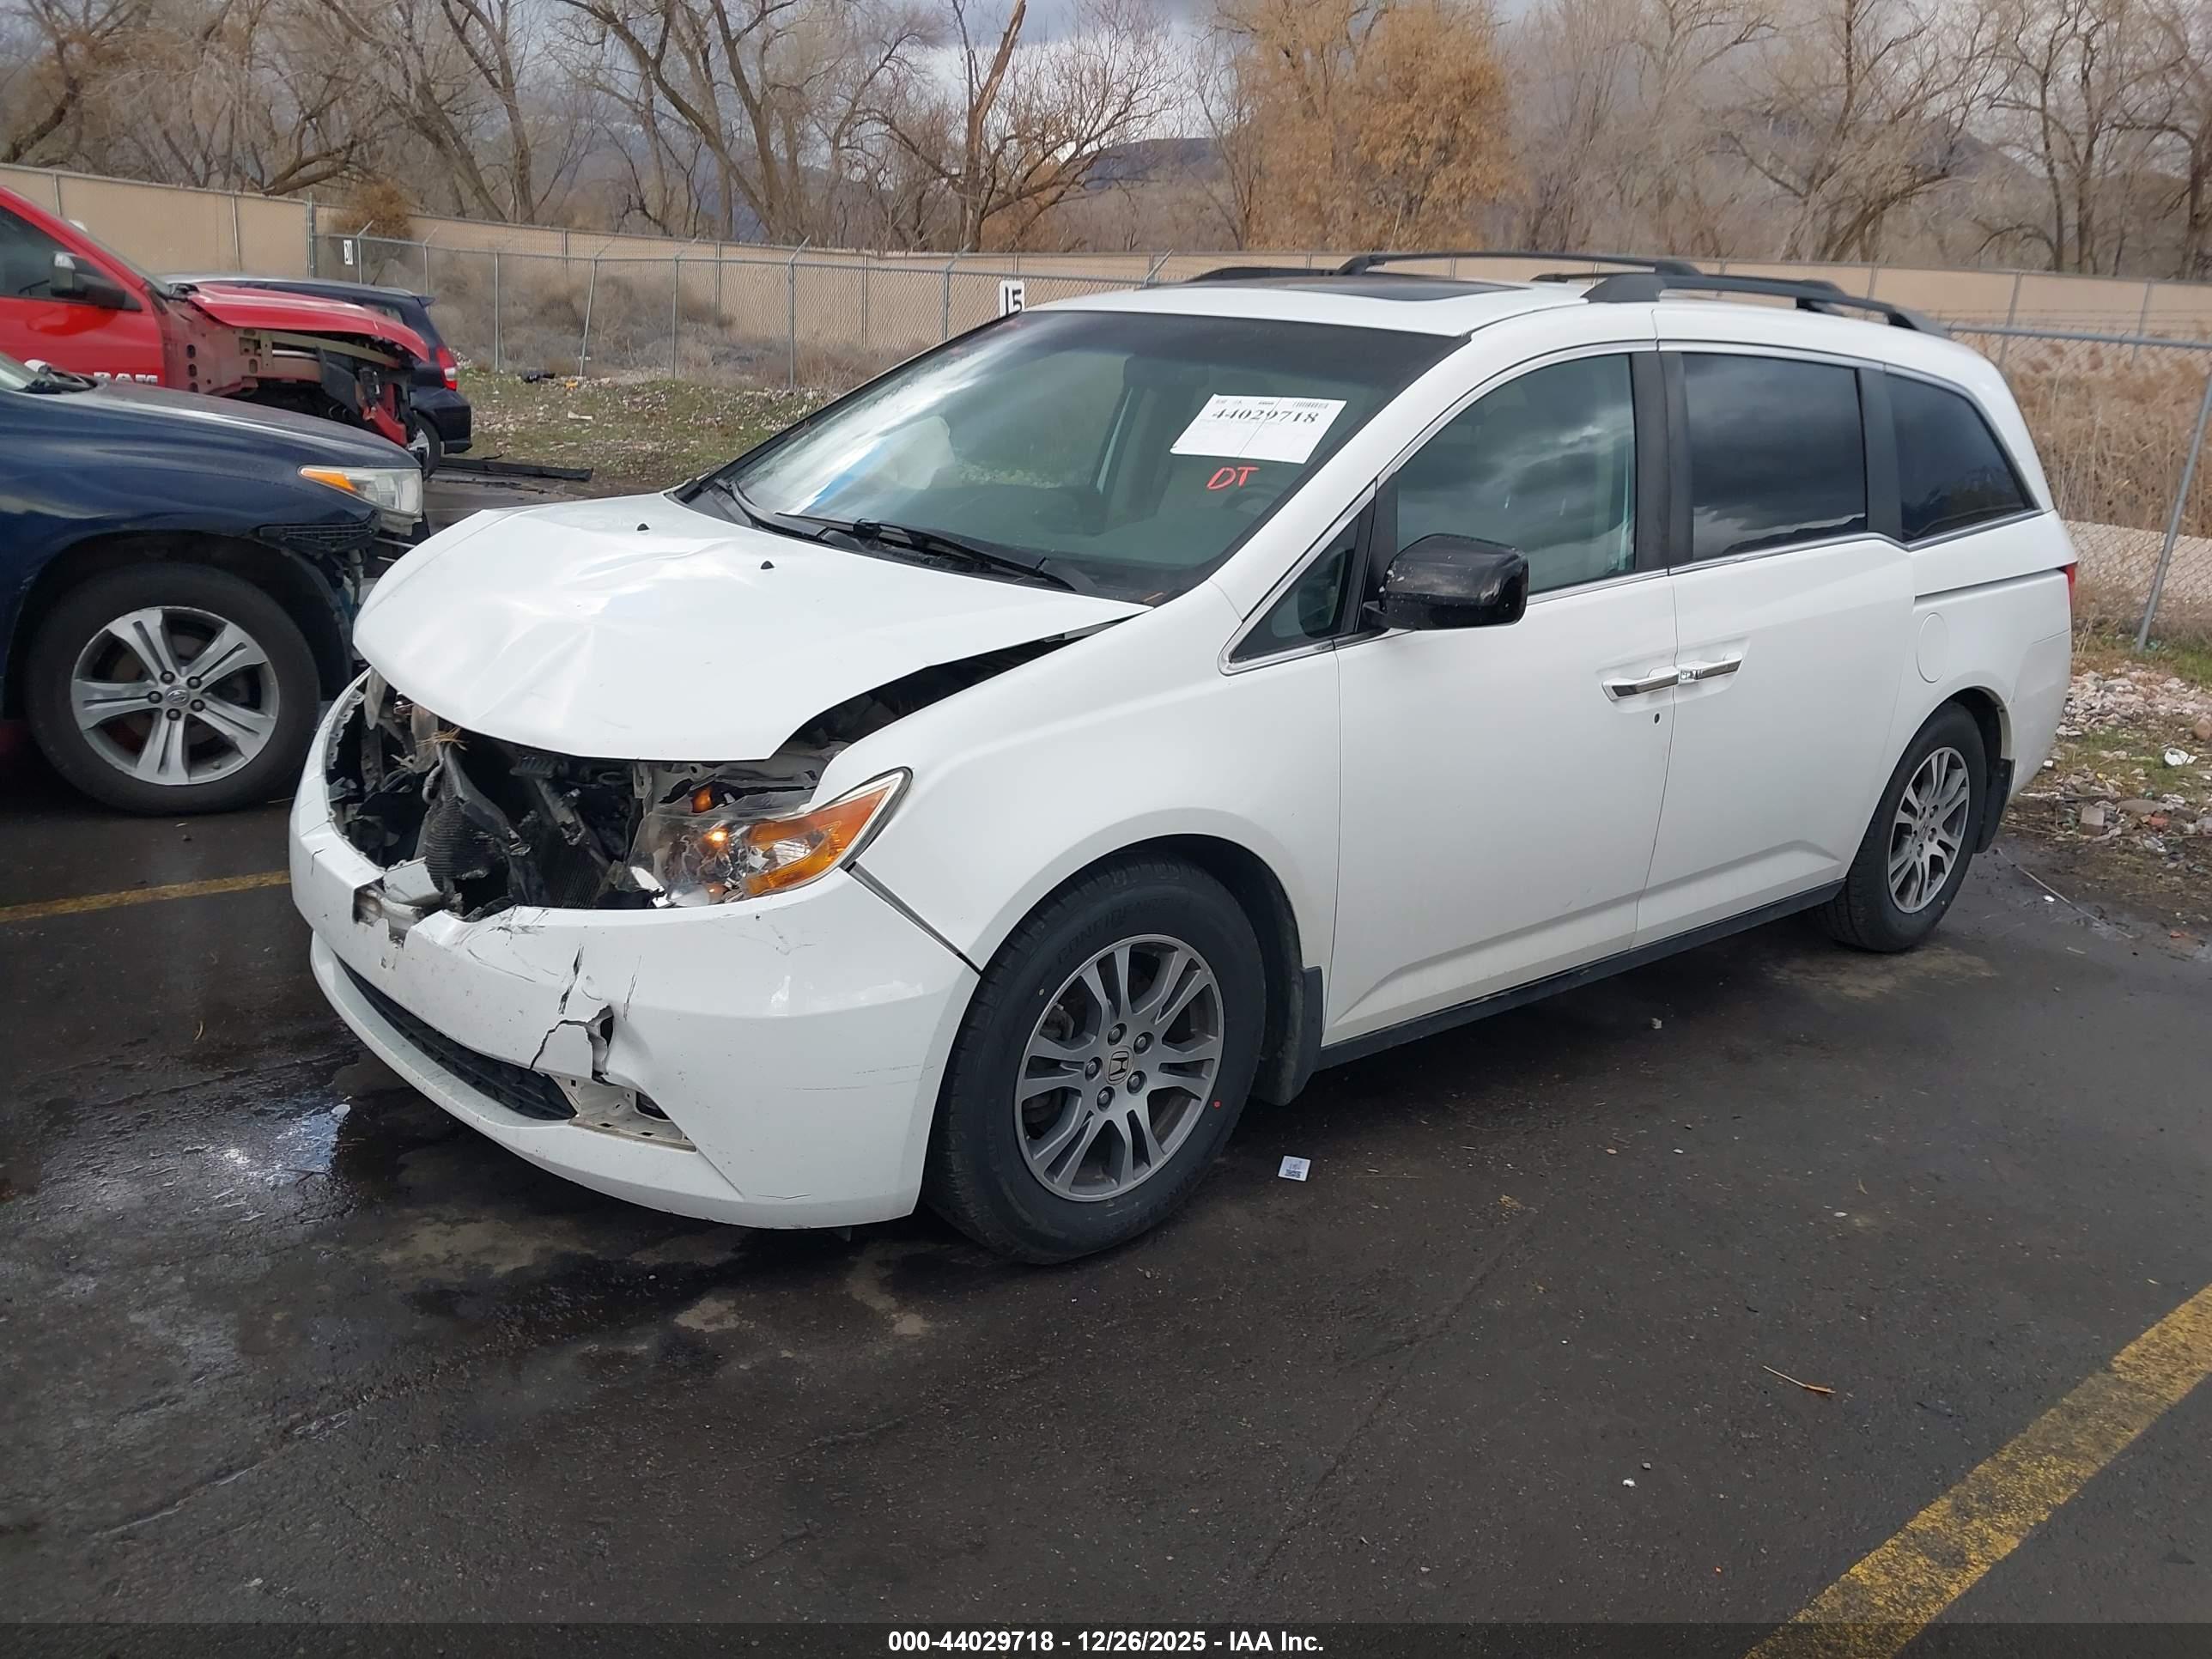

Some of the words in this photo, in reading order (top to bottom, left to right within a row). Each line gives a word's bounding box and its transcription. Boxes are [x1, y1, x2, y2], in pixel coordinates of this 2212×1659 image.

[1005, 286, 1023, 316] 15
[1212, 408, 1319, 424] 44029718
[1207, 466, 1260, 489] DT
